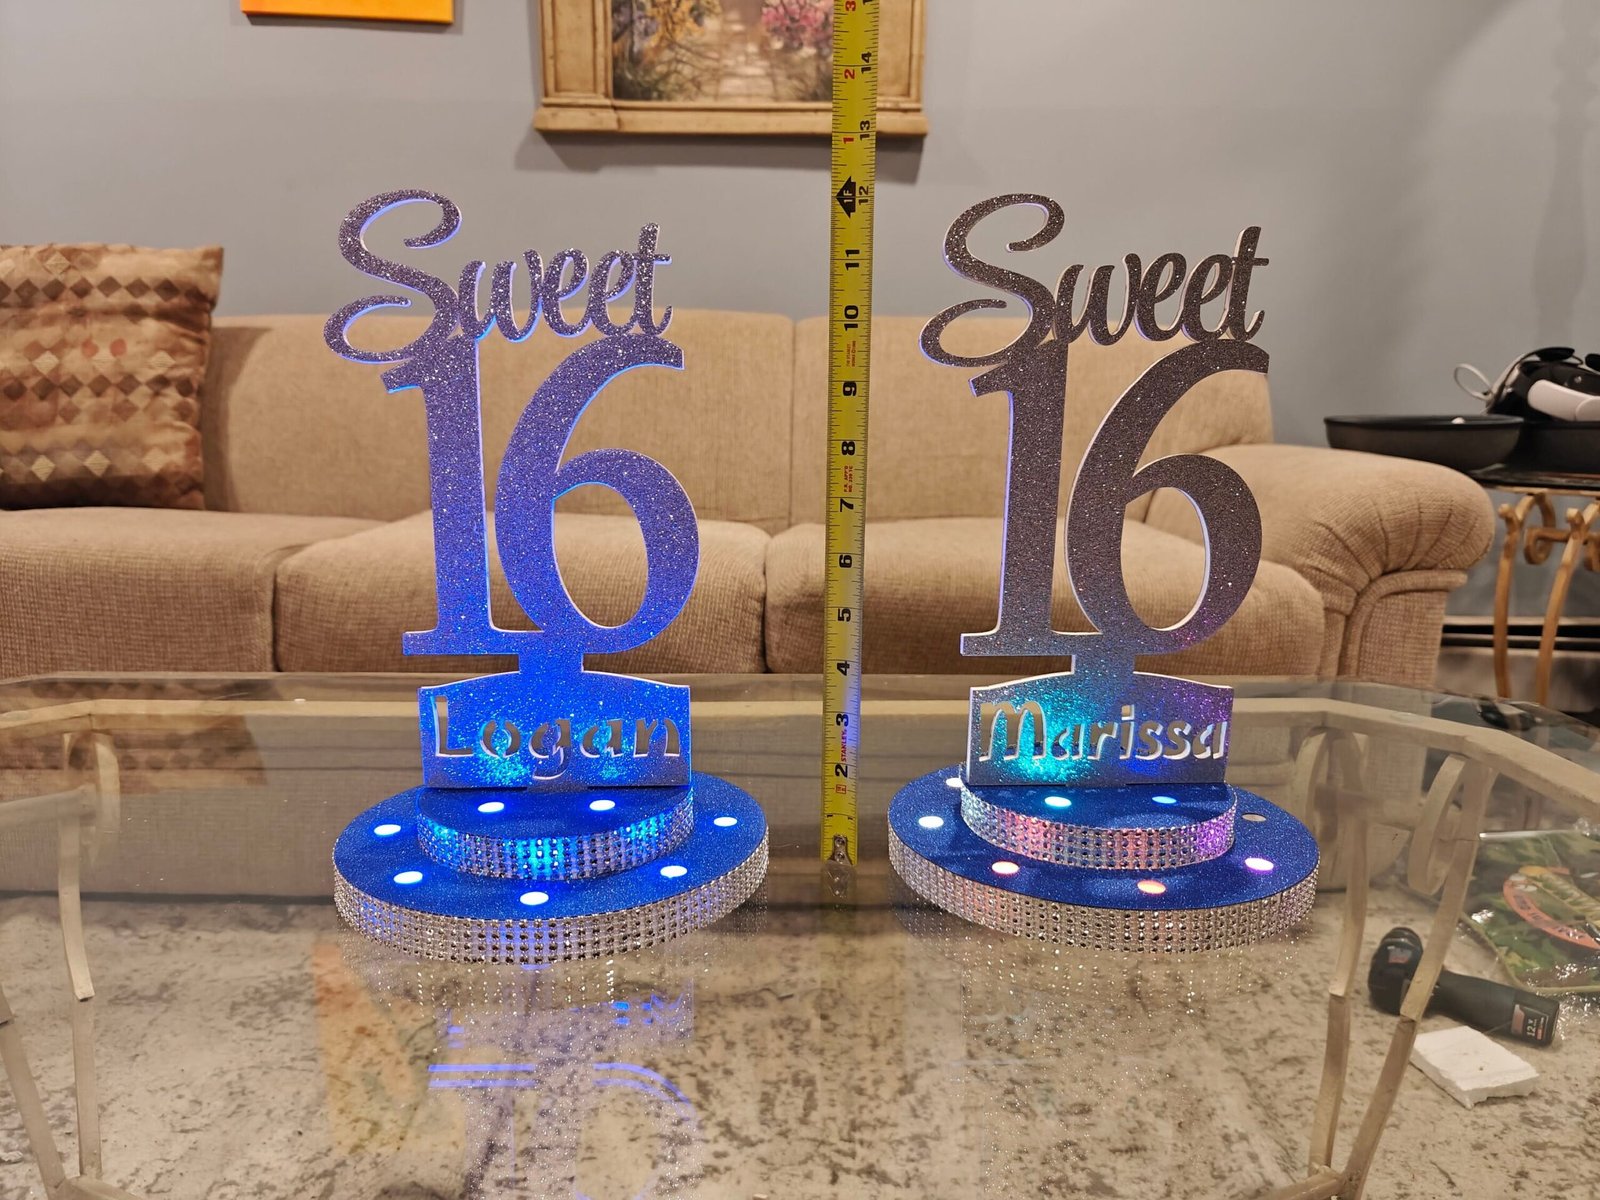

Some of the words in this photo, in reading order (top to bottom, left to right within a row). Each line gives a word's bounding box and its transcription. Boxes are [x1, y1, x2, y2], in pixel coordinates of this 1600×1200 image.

[845, 0, 857, 12] 3
[861, 51, 872, 74] 14
[844, 68, 855, 79] 2
[860, 120, 870, 141] 13
[859, 186, 869, 205] 12
[845, 249, 860, 271] 11
[323, 188, 673, 364] Sweet
[919, 193, 1269, 367] Sweet
[844, 305, 859, 331] 10
[843, 381, 857, 396] 9
[841, 441, 855, 456] 8
[380, 333, 700, 656] 16
[960, 335, 1270, 657] 16
[840, 498, 854, 512] 7
[839, 554, 852, 568] 6
[837, 608, 851, 622] 5
[836, 661, 850, 676] 4
[836, 713, 849, 727] 3
[430, 695, 681, 780] Logan
[978, 700, 1228, 761] Marissa
[834, 764, 848, 778] 2
